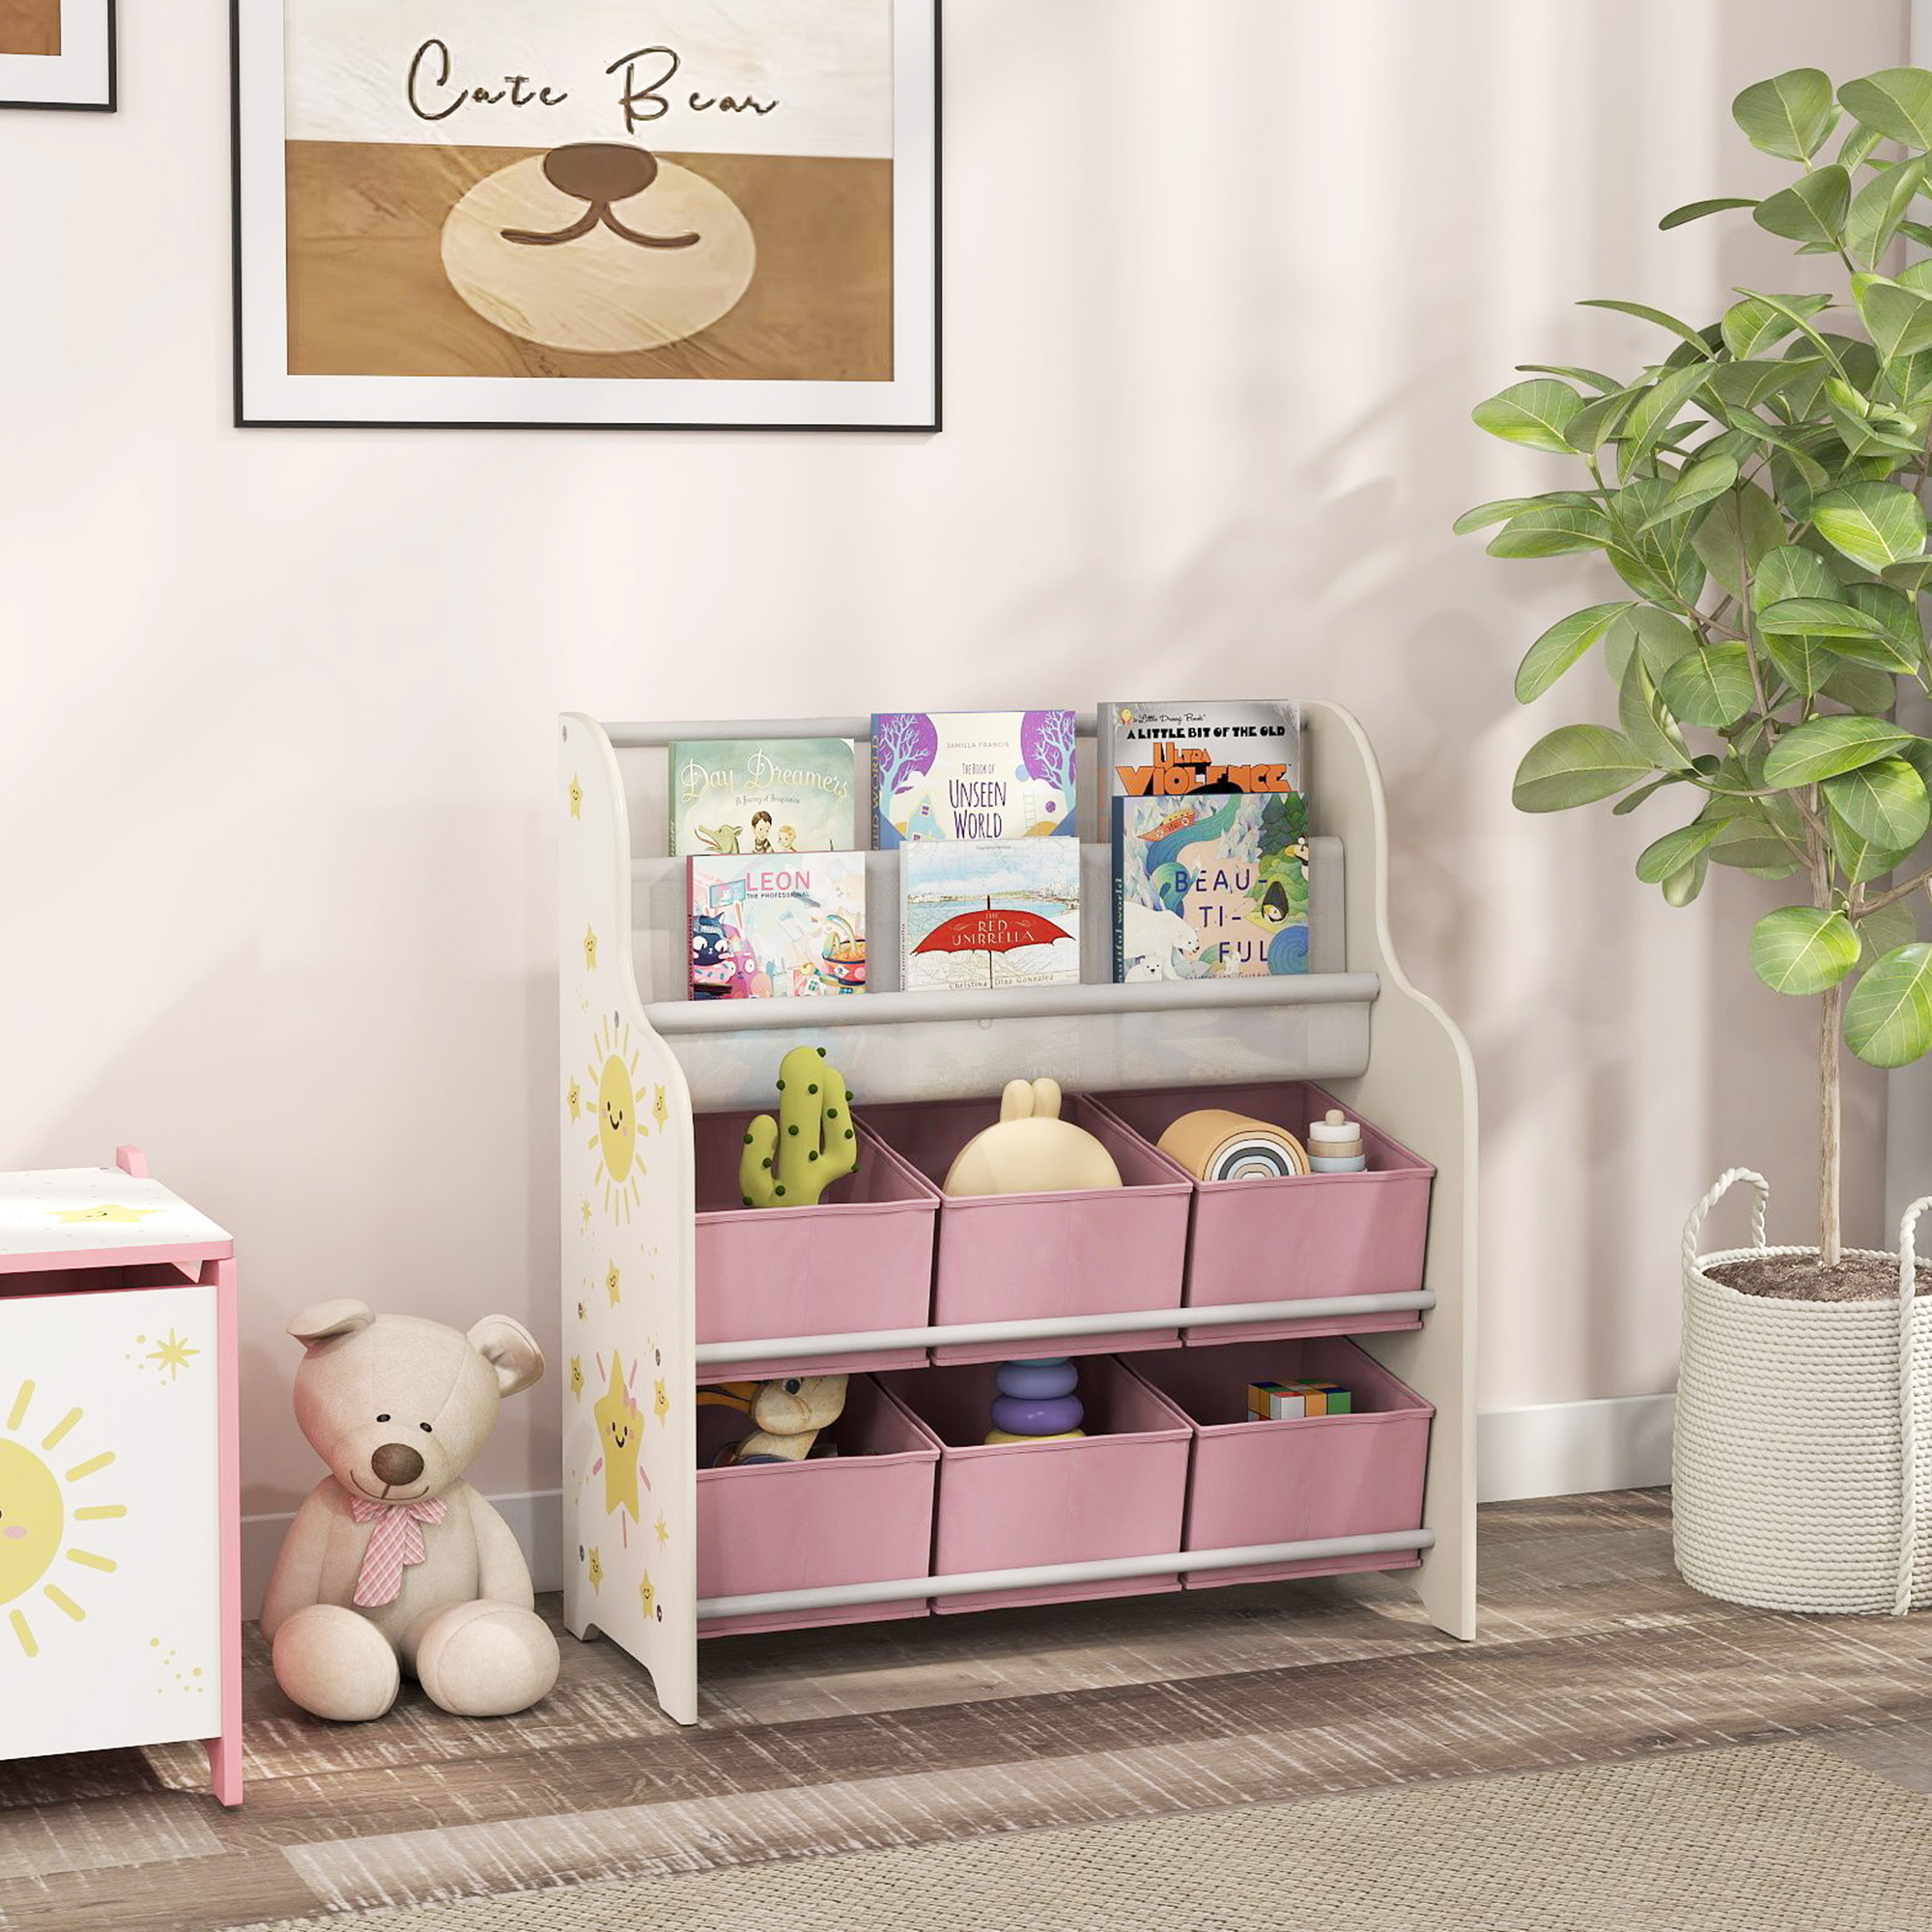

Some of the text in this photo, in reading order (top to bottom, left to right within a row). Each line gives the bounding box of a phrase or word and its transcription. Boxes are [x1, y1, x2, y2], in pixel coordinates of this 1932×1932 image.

[408, 38, 779, 134] Cute Bear
[1126, 725, 1286, 739] A LITTLE BIT OF THE OLD
[681, 749, 848, 802] Day Dreamers
[973, 763, 987, 774] BOOK
[1116, 764, 1293, 795] VIOLENCE
[949, 780, 1007, 809] UNSEEN
[953, 810, 1003, 838] WORLD
[747, 870, 810, 891] LEON
[978, 920, 1008, 933] RED
[952, 930, 1035, 947] UMBRELLA
[1219, 940, 1268, 963] FUL
[949, 980, 987, 990] Christina
[1016, 974, 1054, 984] Gonzalez
